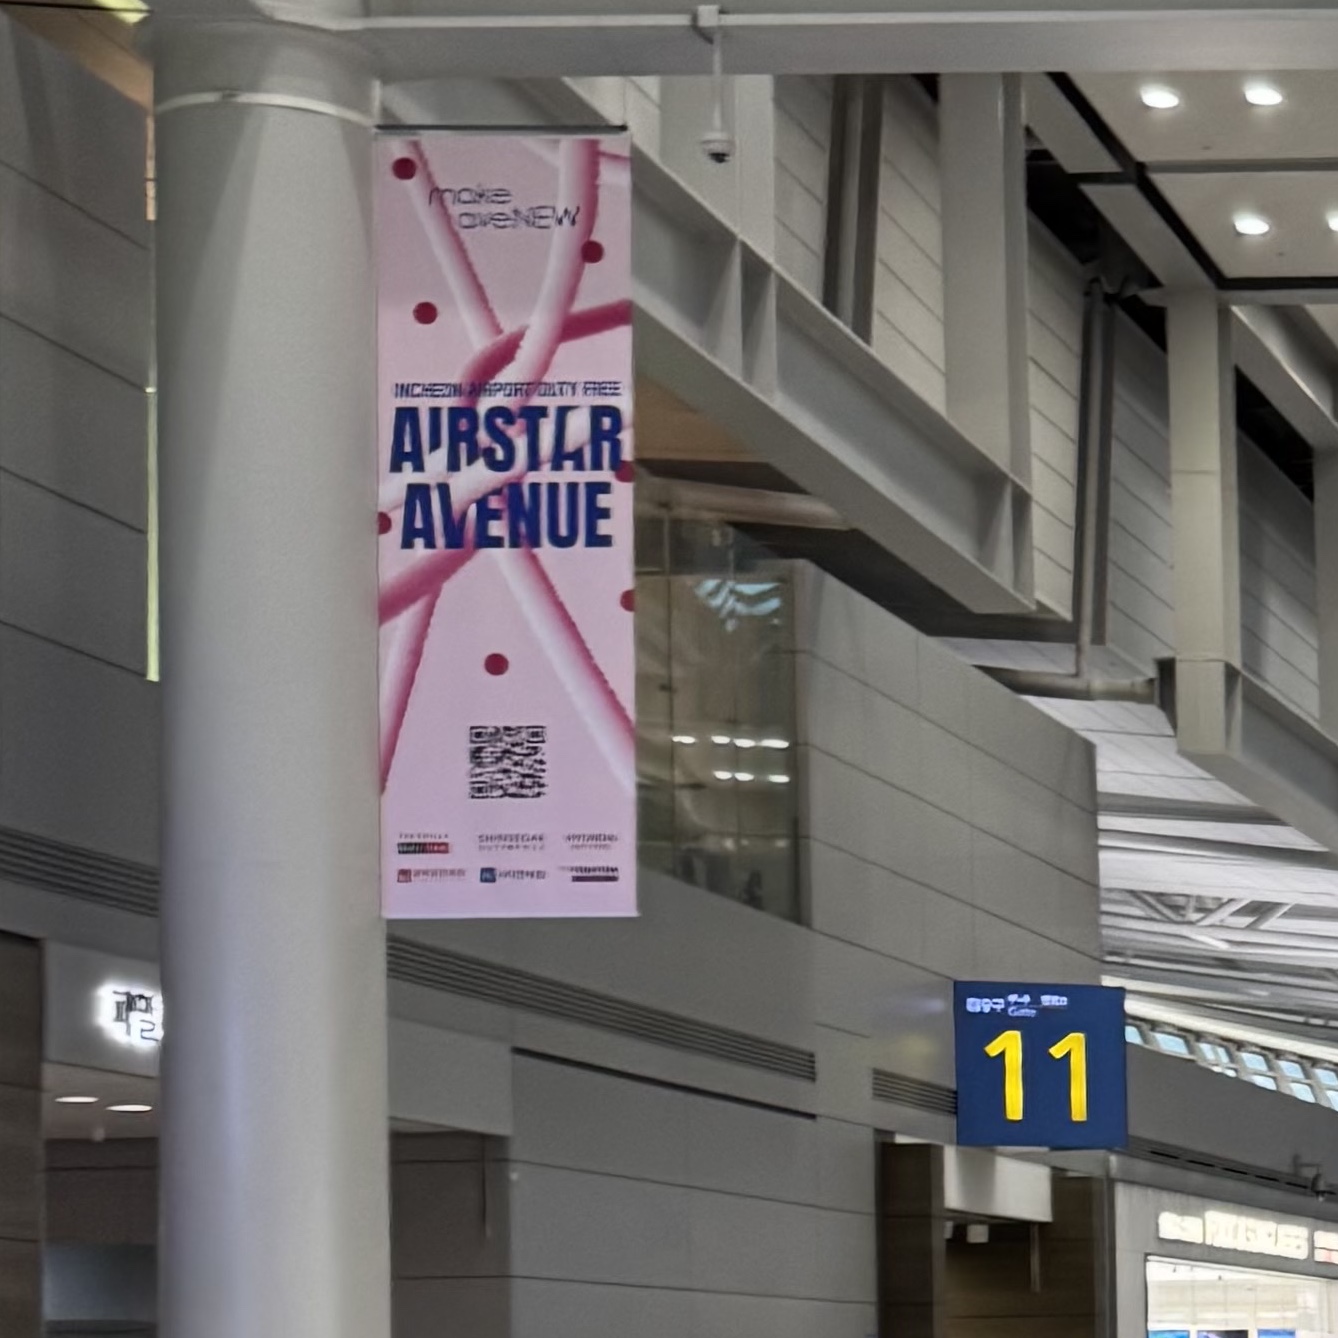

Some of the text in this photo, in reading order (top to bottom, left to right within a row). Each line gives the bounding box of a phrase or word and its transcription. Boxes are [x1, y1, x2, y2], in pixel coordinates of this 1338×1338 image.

[394, 382, 462, 399] INCHEON
[389, 405, 623, 474] AIRSTAR
[400, 481, 613, 550] AVENUE
[984, 1029, 1088, 1122] 11
